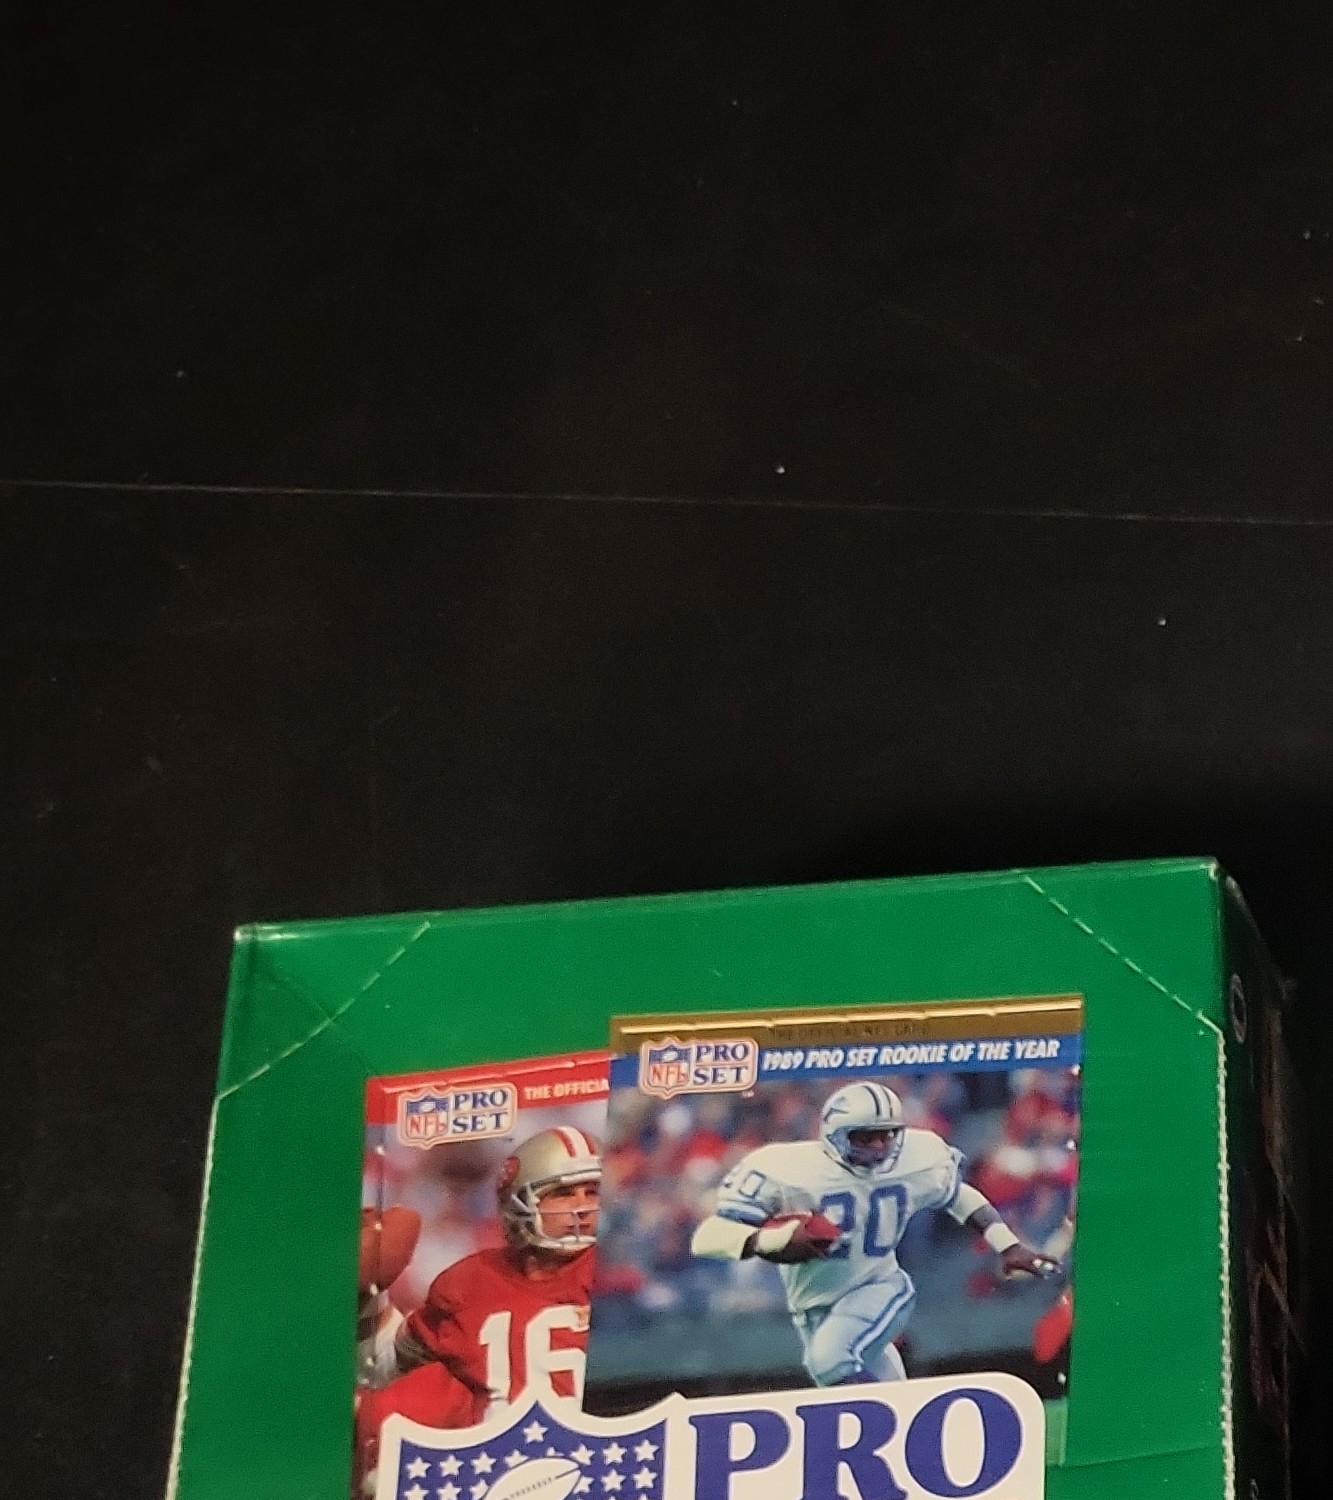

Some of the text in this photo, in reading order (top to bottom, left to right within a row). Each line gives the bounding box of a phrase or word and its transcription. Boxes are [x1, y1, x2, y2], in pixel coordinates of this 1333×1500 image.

[696, 1043, 749, 1063] PRO
[763, 1038, 1060, 1070] 1989 PRO SET ROOKIE OF THE YEAR
[651, 1064, 687, 1084] NFL
[693, 1065, 749, 1086] SET
[453, 1089, 508, 1111] PRO
[525, 1086, 551, 1100] THE
[409, 1112, 447, 1134] NFL
[452, 1111, 508, 1134] SET
[478, 1304, 590, 1403] 16
